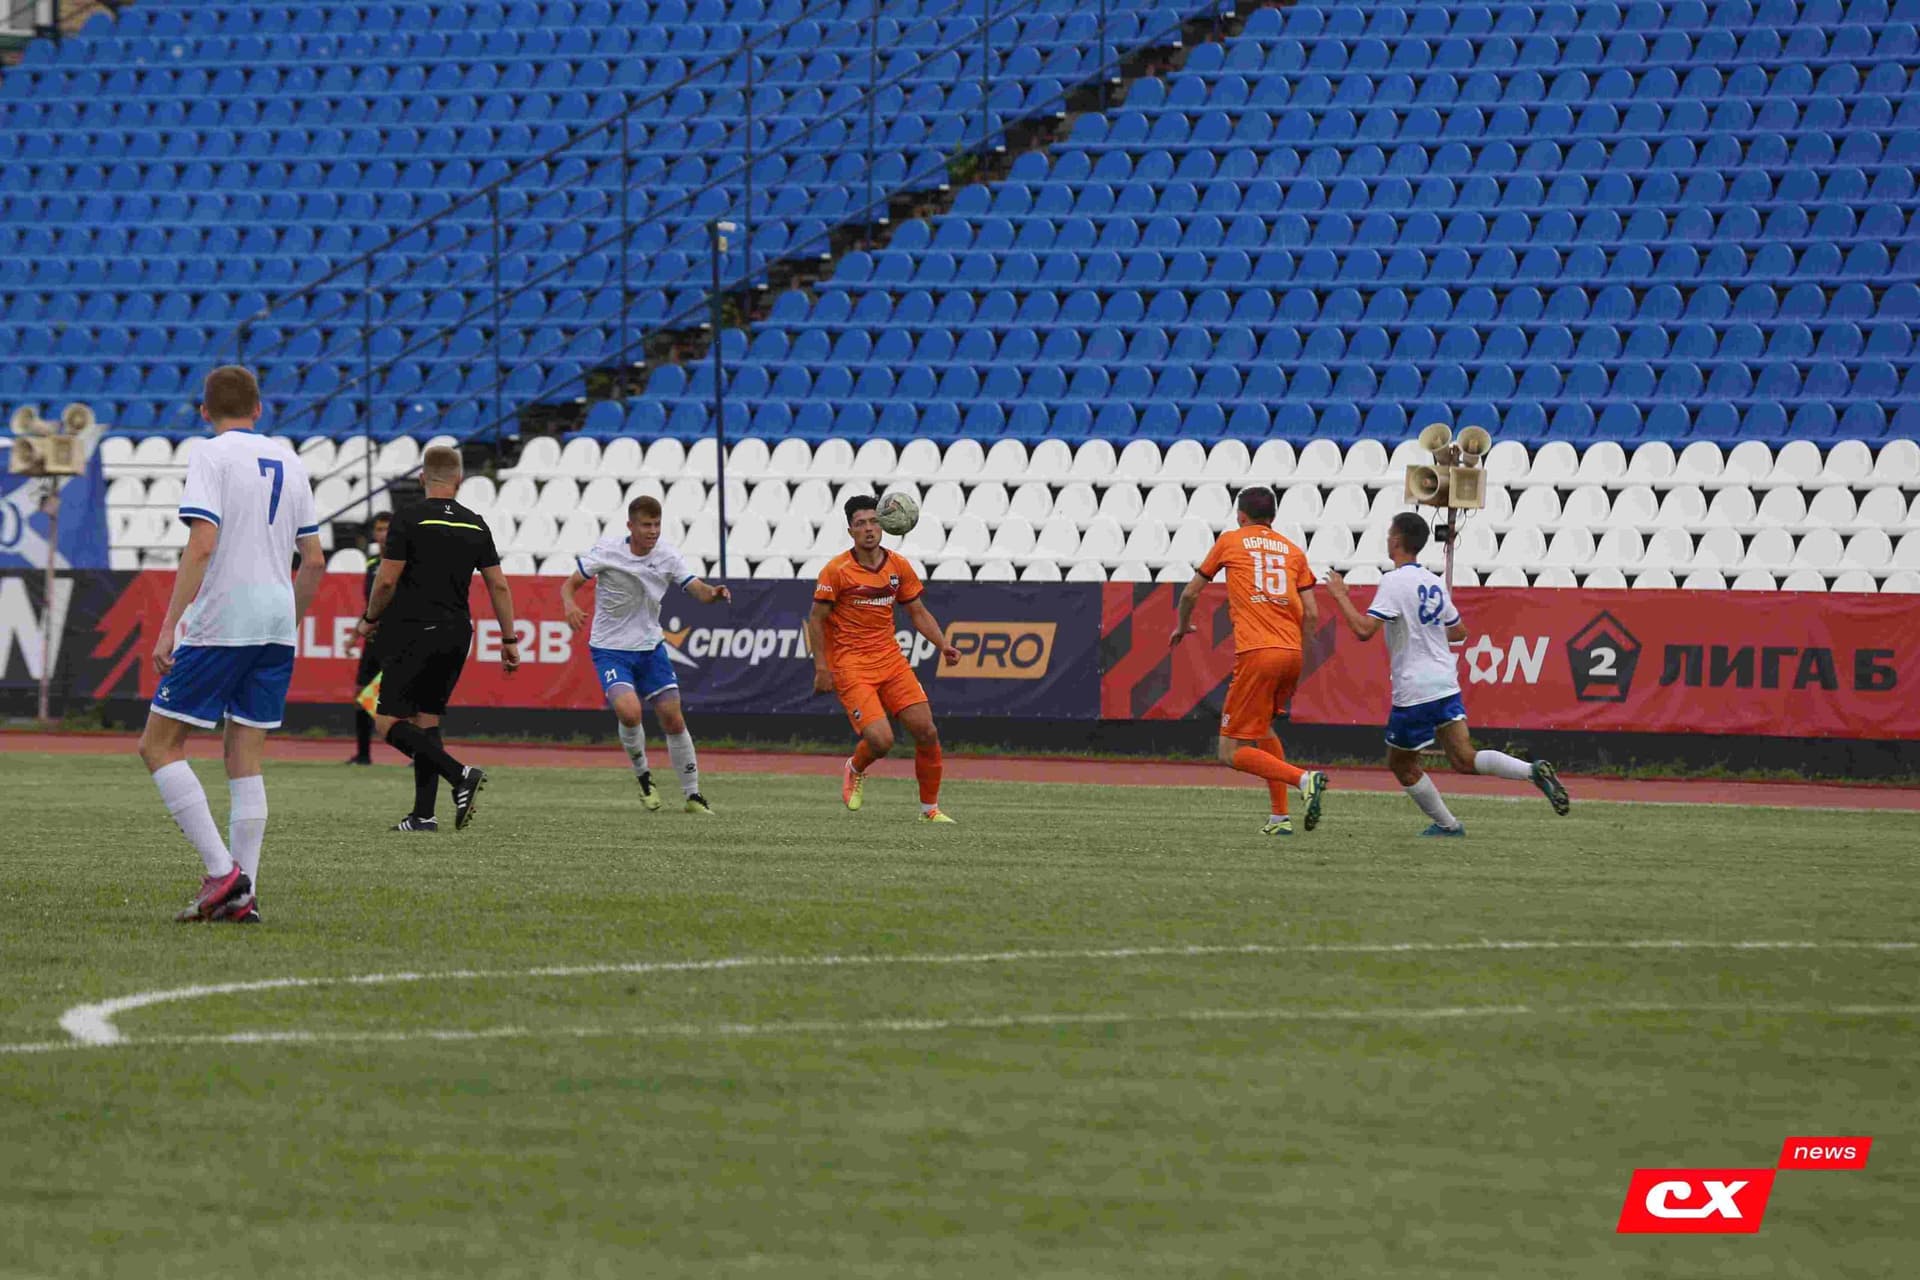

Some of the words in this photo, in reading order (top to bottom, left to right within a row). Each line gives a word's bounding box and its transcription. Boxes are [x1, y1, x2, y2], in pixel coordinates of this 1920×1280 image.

[258, 458, 284, 525] 7
[1249, 551, 1287, 595] 15
[1418, 585, 1444, 625] 22
[950, 632, 1044, 668] PRO
[1588, 647, 1617, 676] 2
[1659, 644, 1839, 690] ЛИГА
[1853, 649, 1898, 692] Б
[604, 668, 618, 683] 21
